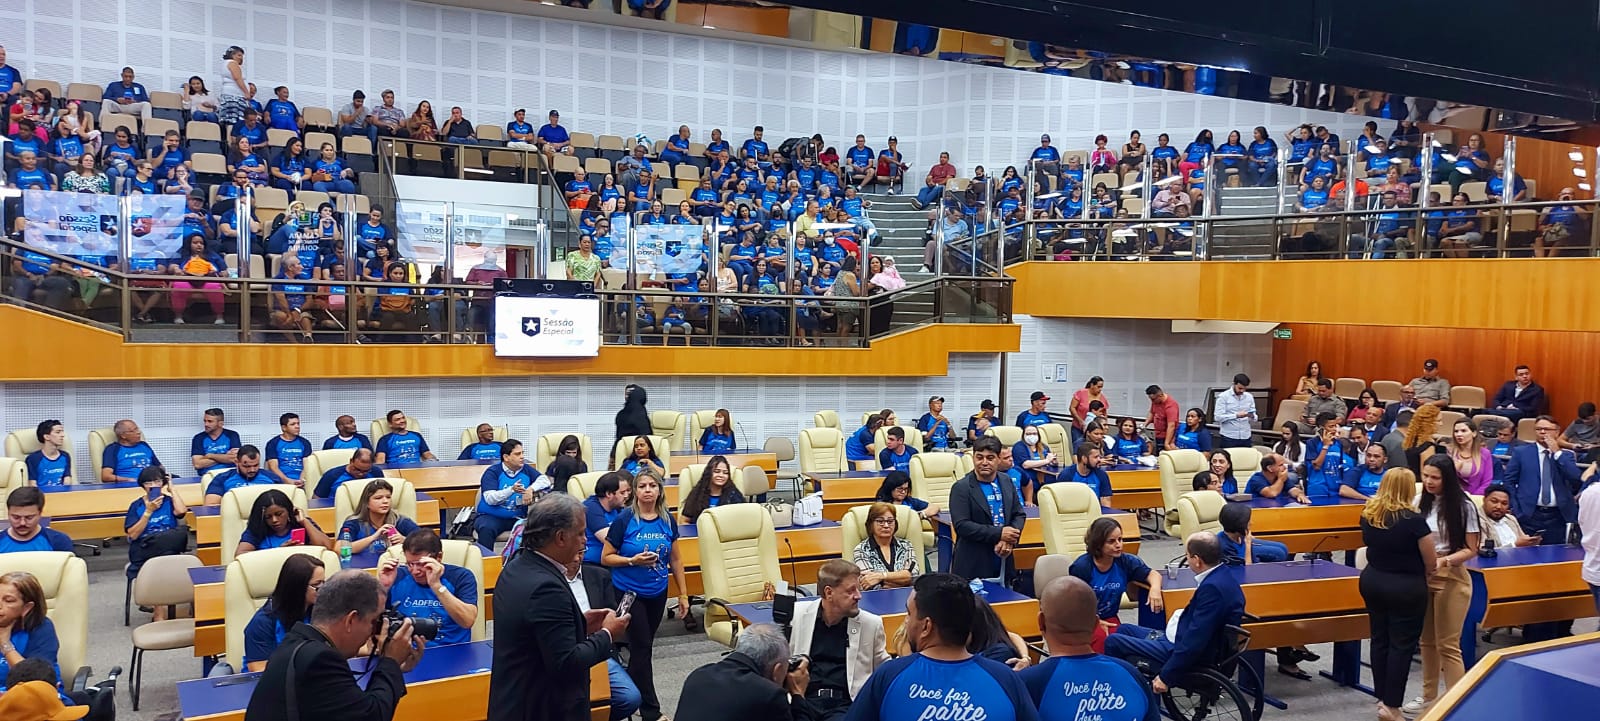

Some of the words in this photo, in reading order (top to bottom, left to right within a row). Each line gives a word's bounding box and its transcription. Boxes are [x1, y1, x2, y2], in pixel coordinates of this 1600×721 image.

[543, 317, 574, 327] Sessão
[542, 327, 574, 336] Especial
[909, 683, 942, 699] Você
[943, 687, 971, 706] faz
[1063, 681, 1090, 697] Você
[1091, 679, 1112, 697] faz
[917, 702, 987, 721] parte
[1074, 693, 1127, 721] parte
